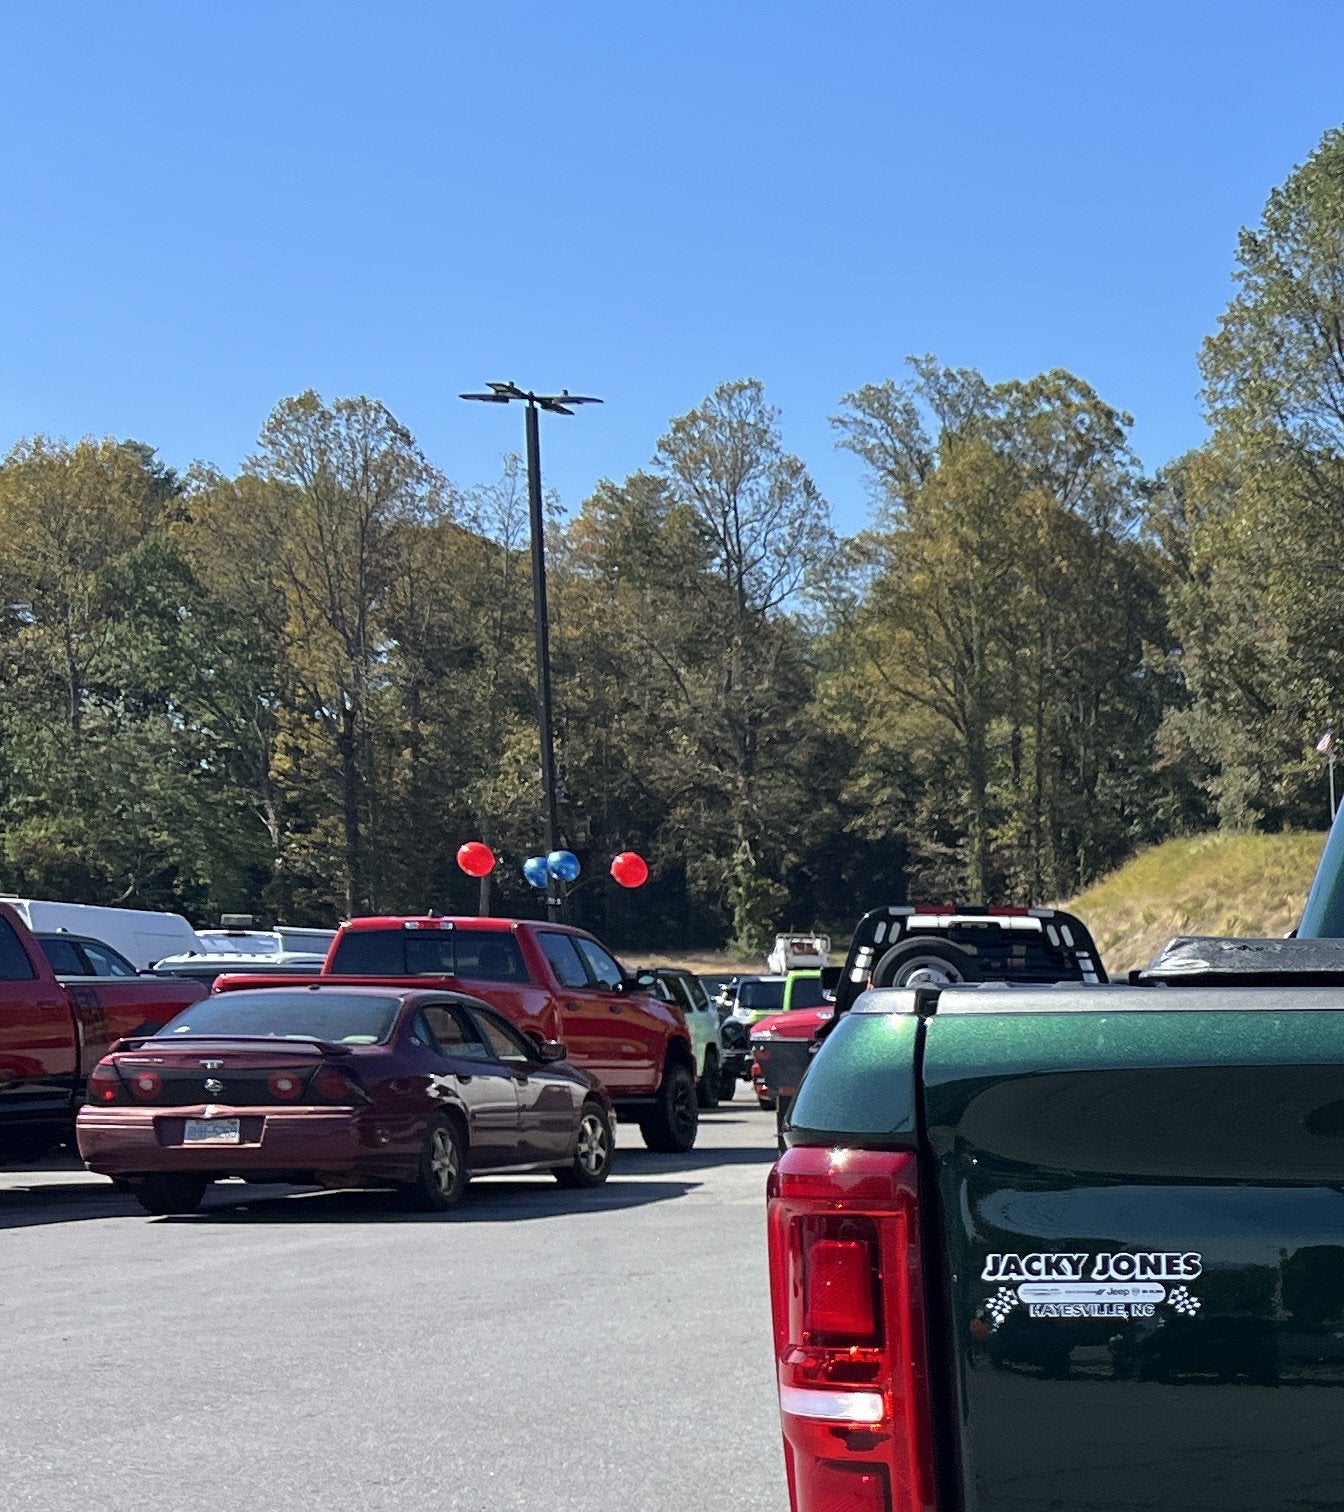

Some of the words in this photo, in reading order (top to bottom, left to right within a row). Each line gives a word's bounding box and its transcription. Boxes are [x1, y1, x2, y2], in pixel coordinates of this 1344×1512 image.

[981, 1253, 1089, 1281] JACKY
[1091, 1252, 1203, 1281] JONES
[1107, 1287, 1129, 1297] Jeep
[1131, 1304, 1155, 1317] NC
